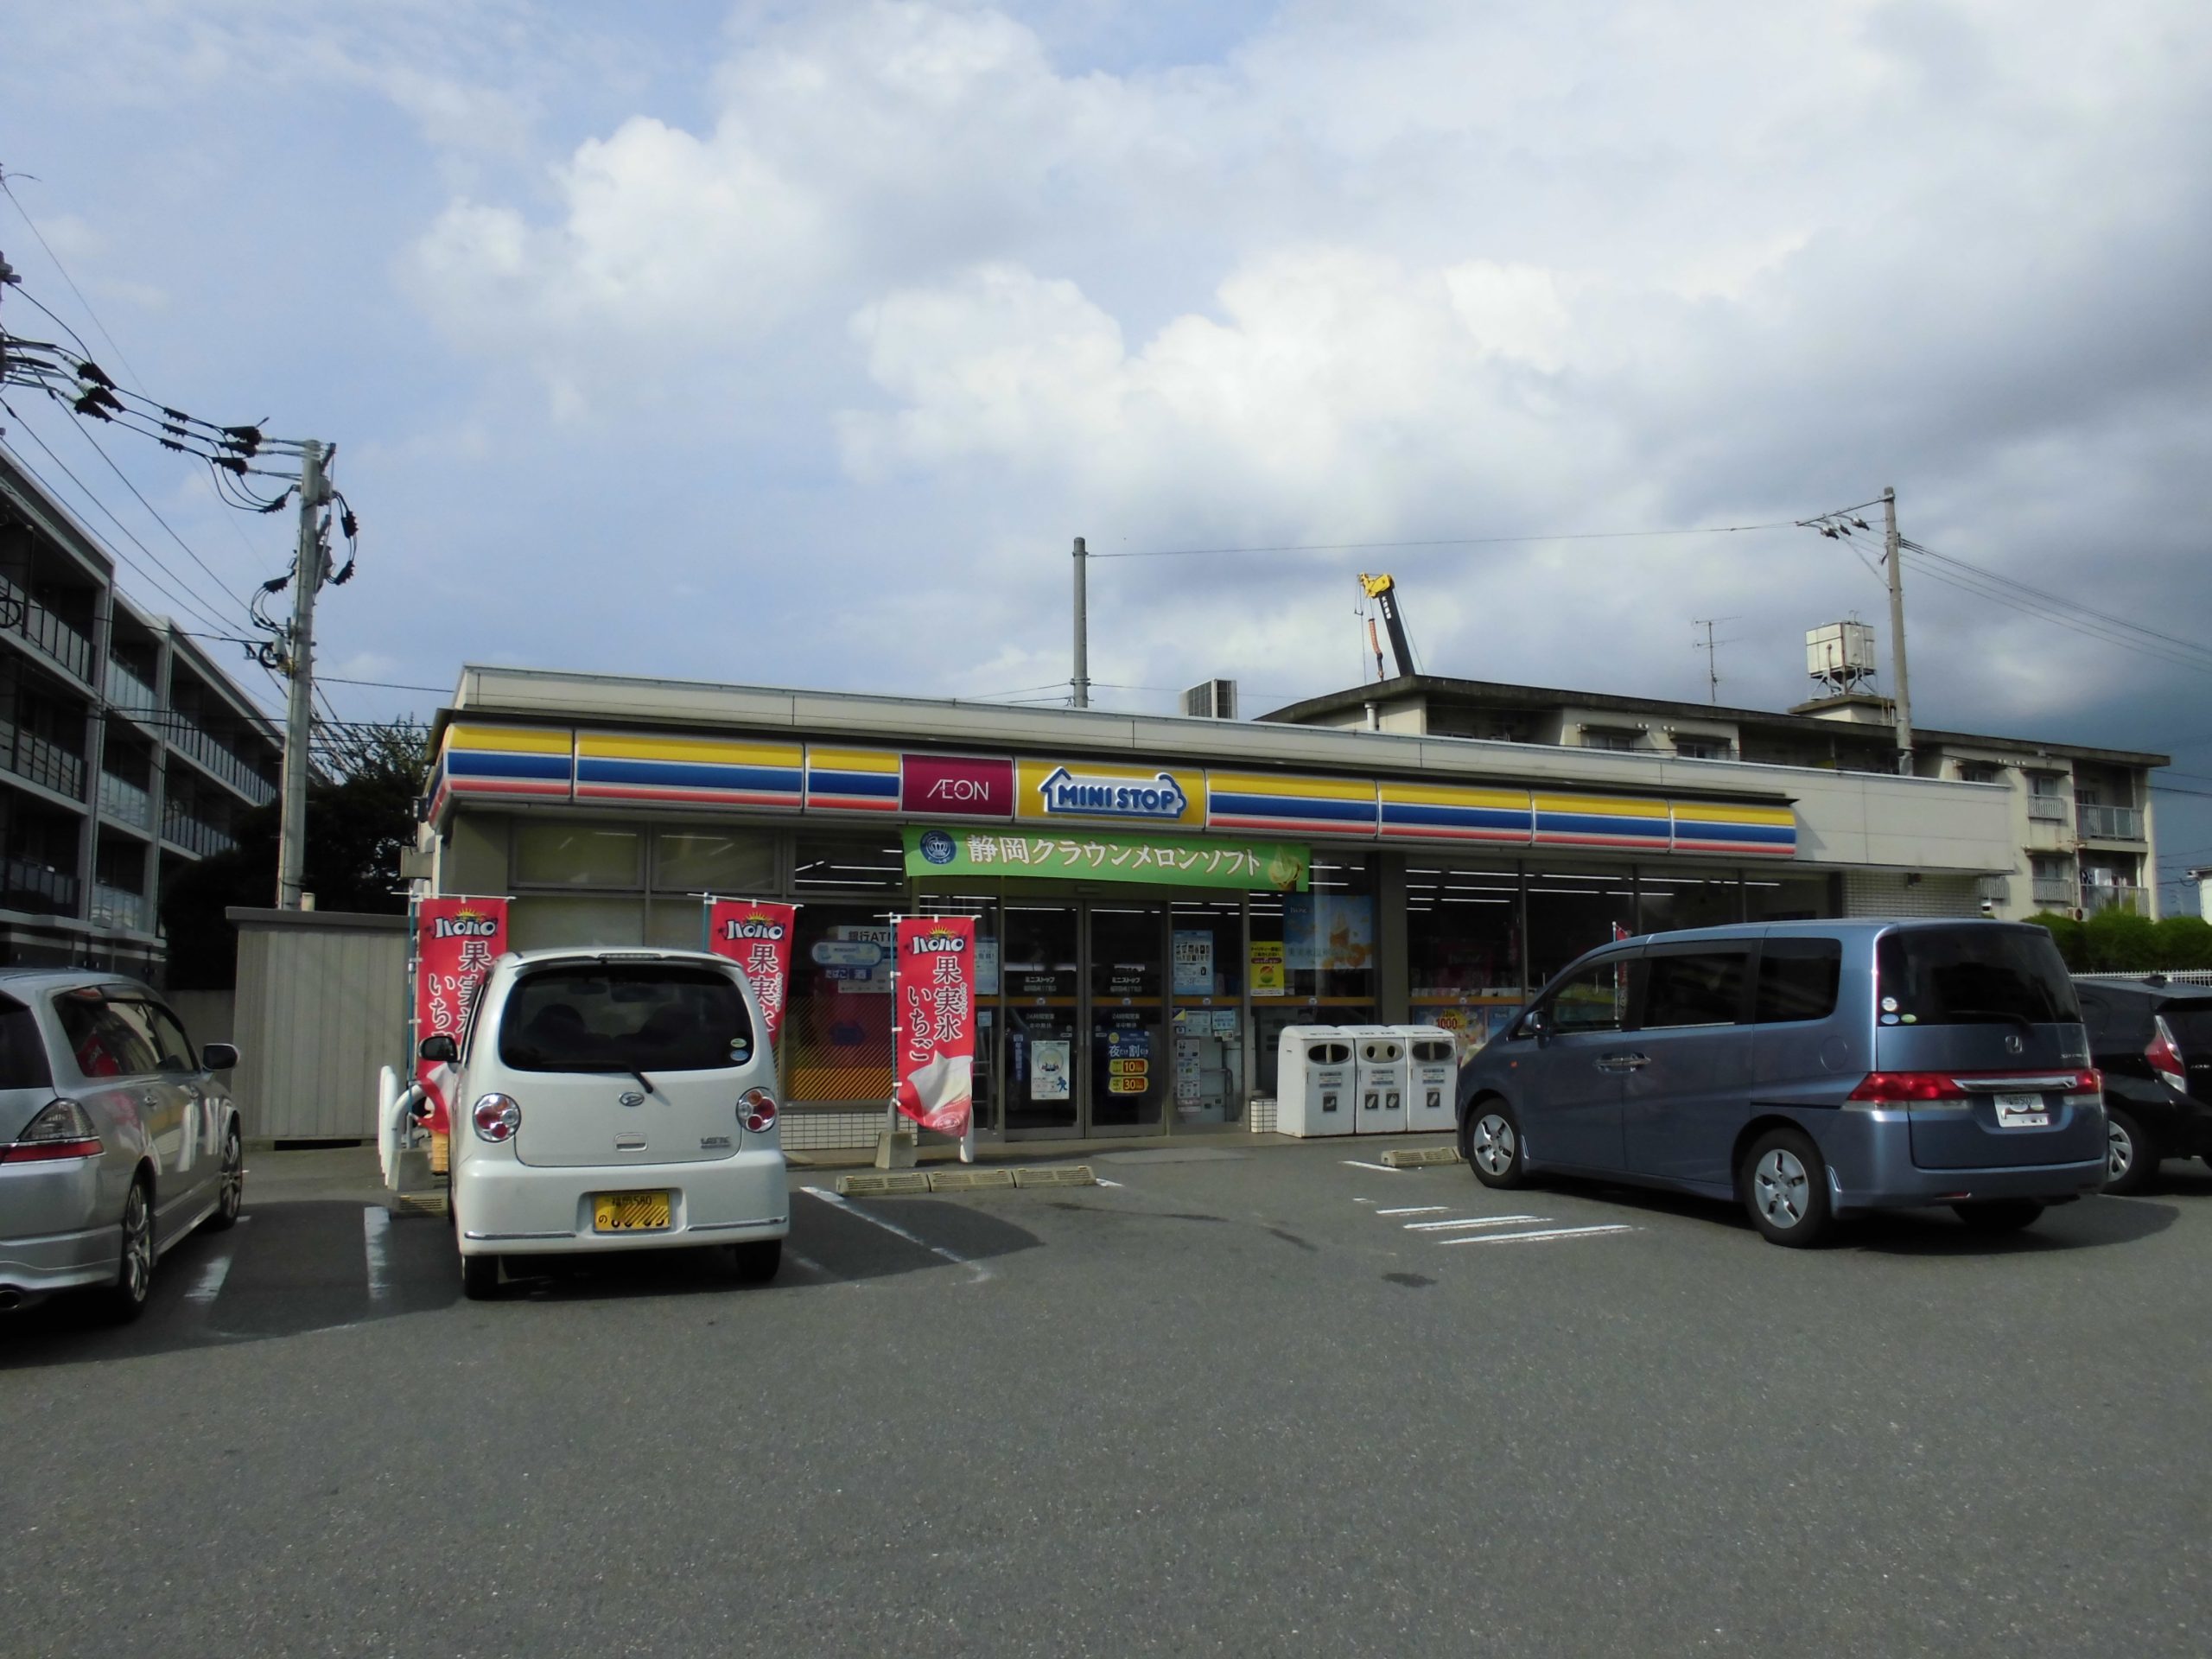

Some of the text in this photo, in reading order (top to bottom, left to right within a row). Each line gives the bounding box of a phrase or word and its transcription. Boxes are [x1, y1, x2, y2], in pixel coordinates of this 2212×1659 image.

[966, 834, 1262, 877] 静岡クラウンメロンソフト
[428, 973, 456, 1038] いち
[907, 985, 934, 1062] いちご
[933, 956, 963, 1042] 果実氷
